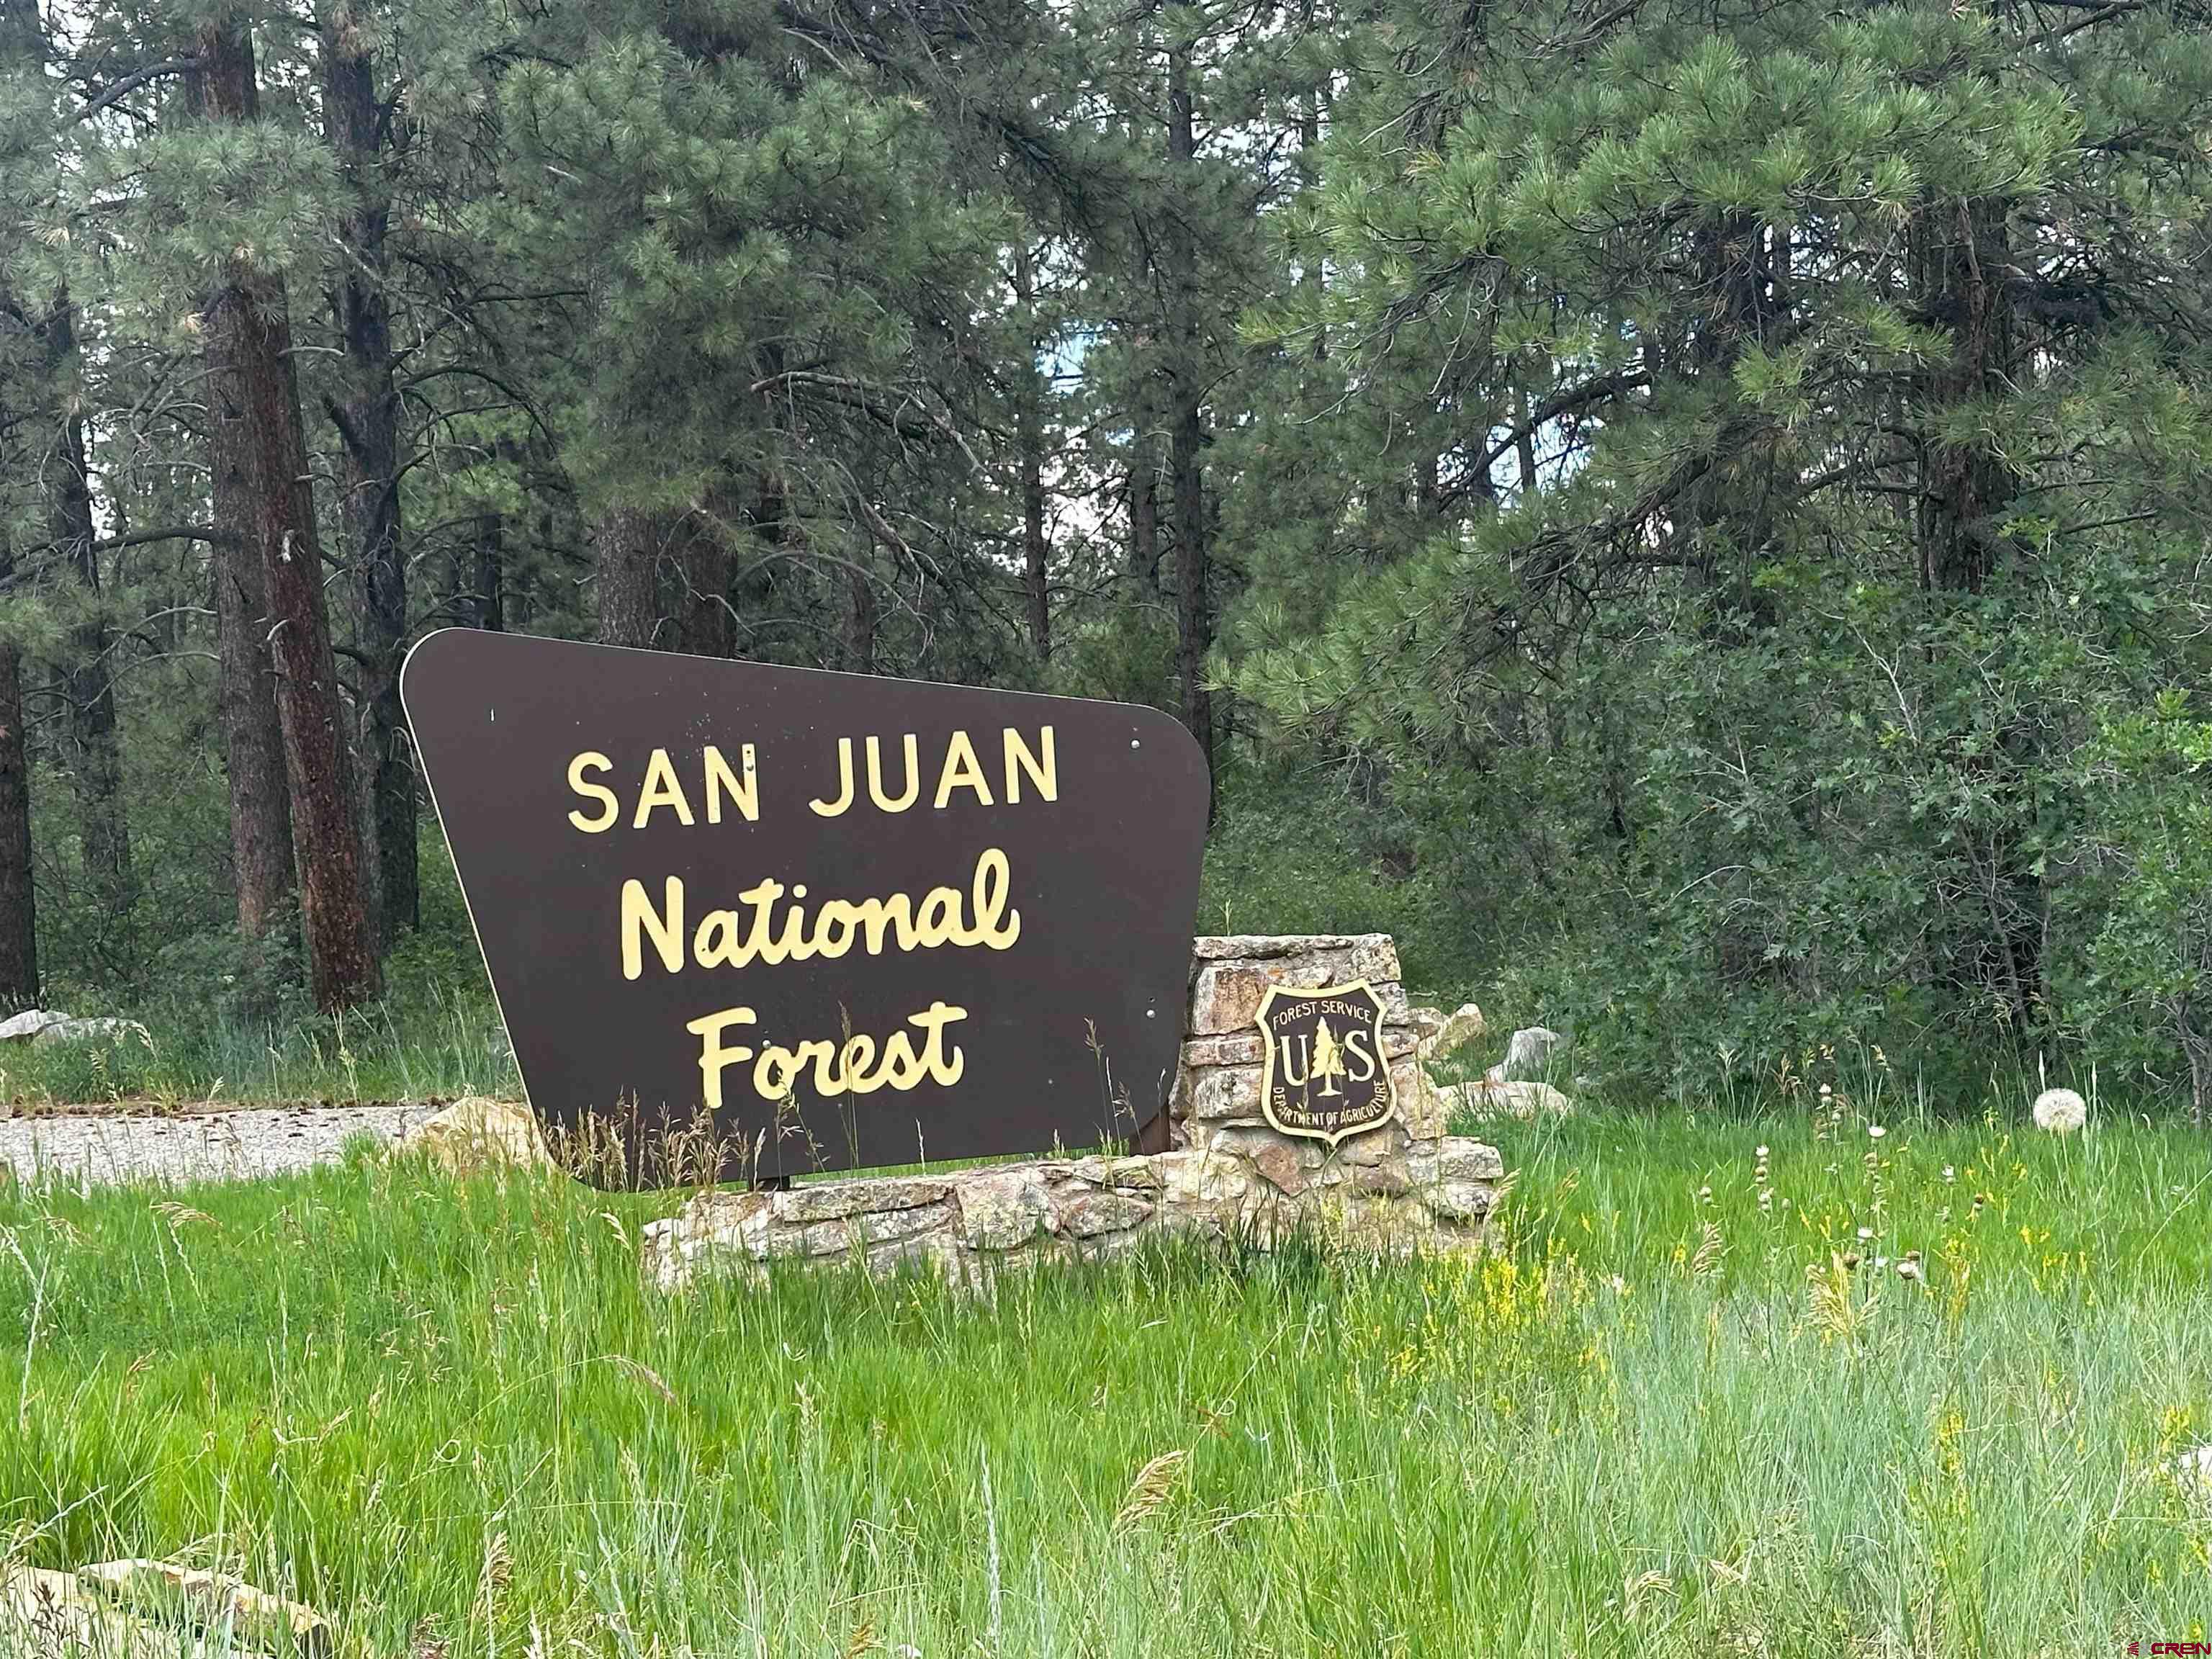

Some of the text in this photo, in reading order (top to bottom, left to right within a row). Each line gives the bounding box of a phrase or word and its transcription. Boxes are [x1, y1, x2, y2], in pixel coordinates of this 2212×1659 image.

[567, 725, 1058, 833] SAN JUAN
[621, 848, 1020, 980] National
[686, 1001, 968, 1109] Forest
[1272, 1000, 1372, 1030] FOREST SERVICE
[1273, 1080, 1385, 1125] DEPARTMENT OF AGRICULTURE
